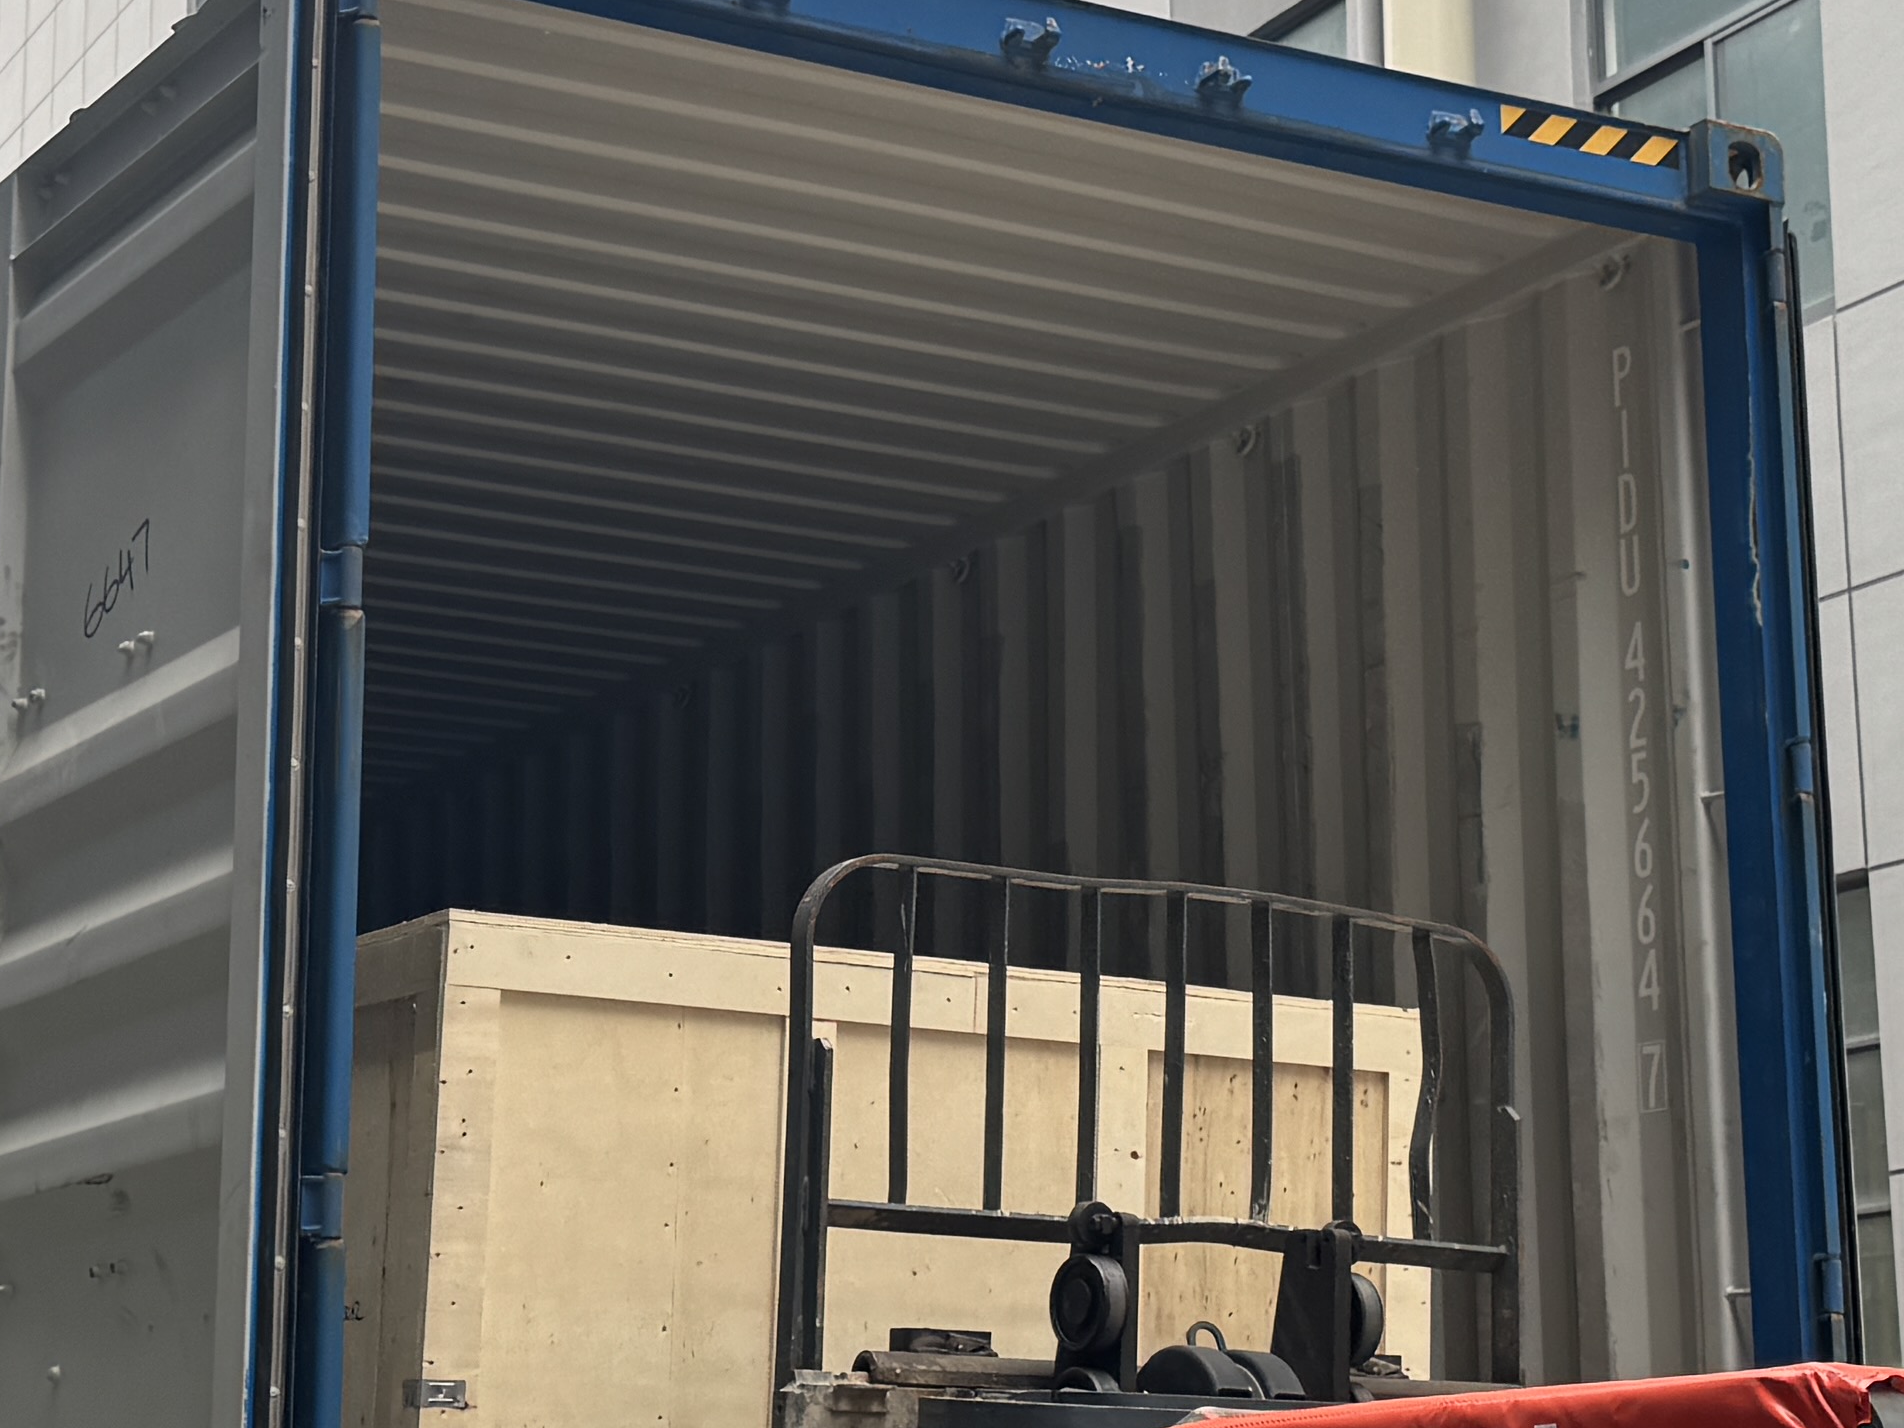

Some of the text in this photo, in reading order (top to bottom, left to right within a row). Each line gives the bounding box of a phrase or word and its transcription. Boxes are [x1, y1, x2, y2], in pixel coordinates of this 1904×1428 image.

[83, 517, 150, 639] 6647
[1612, 345, 1662, 1109] PIDU 425664 7
